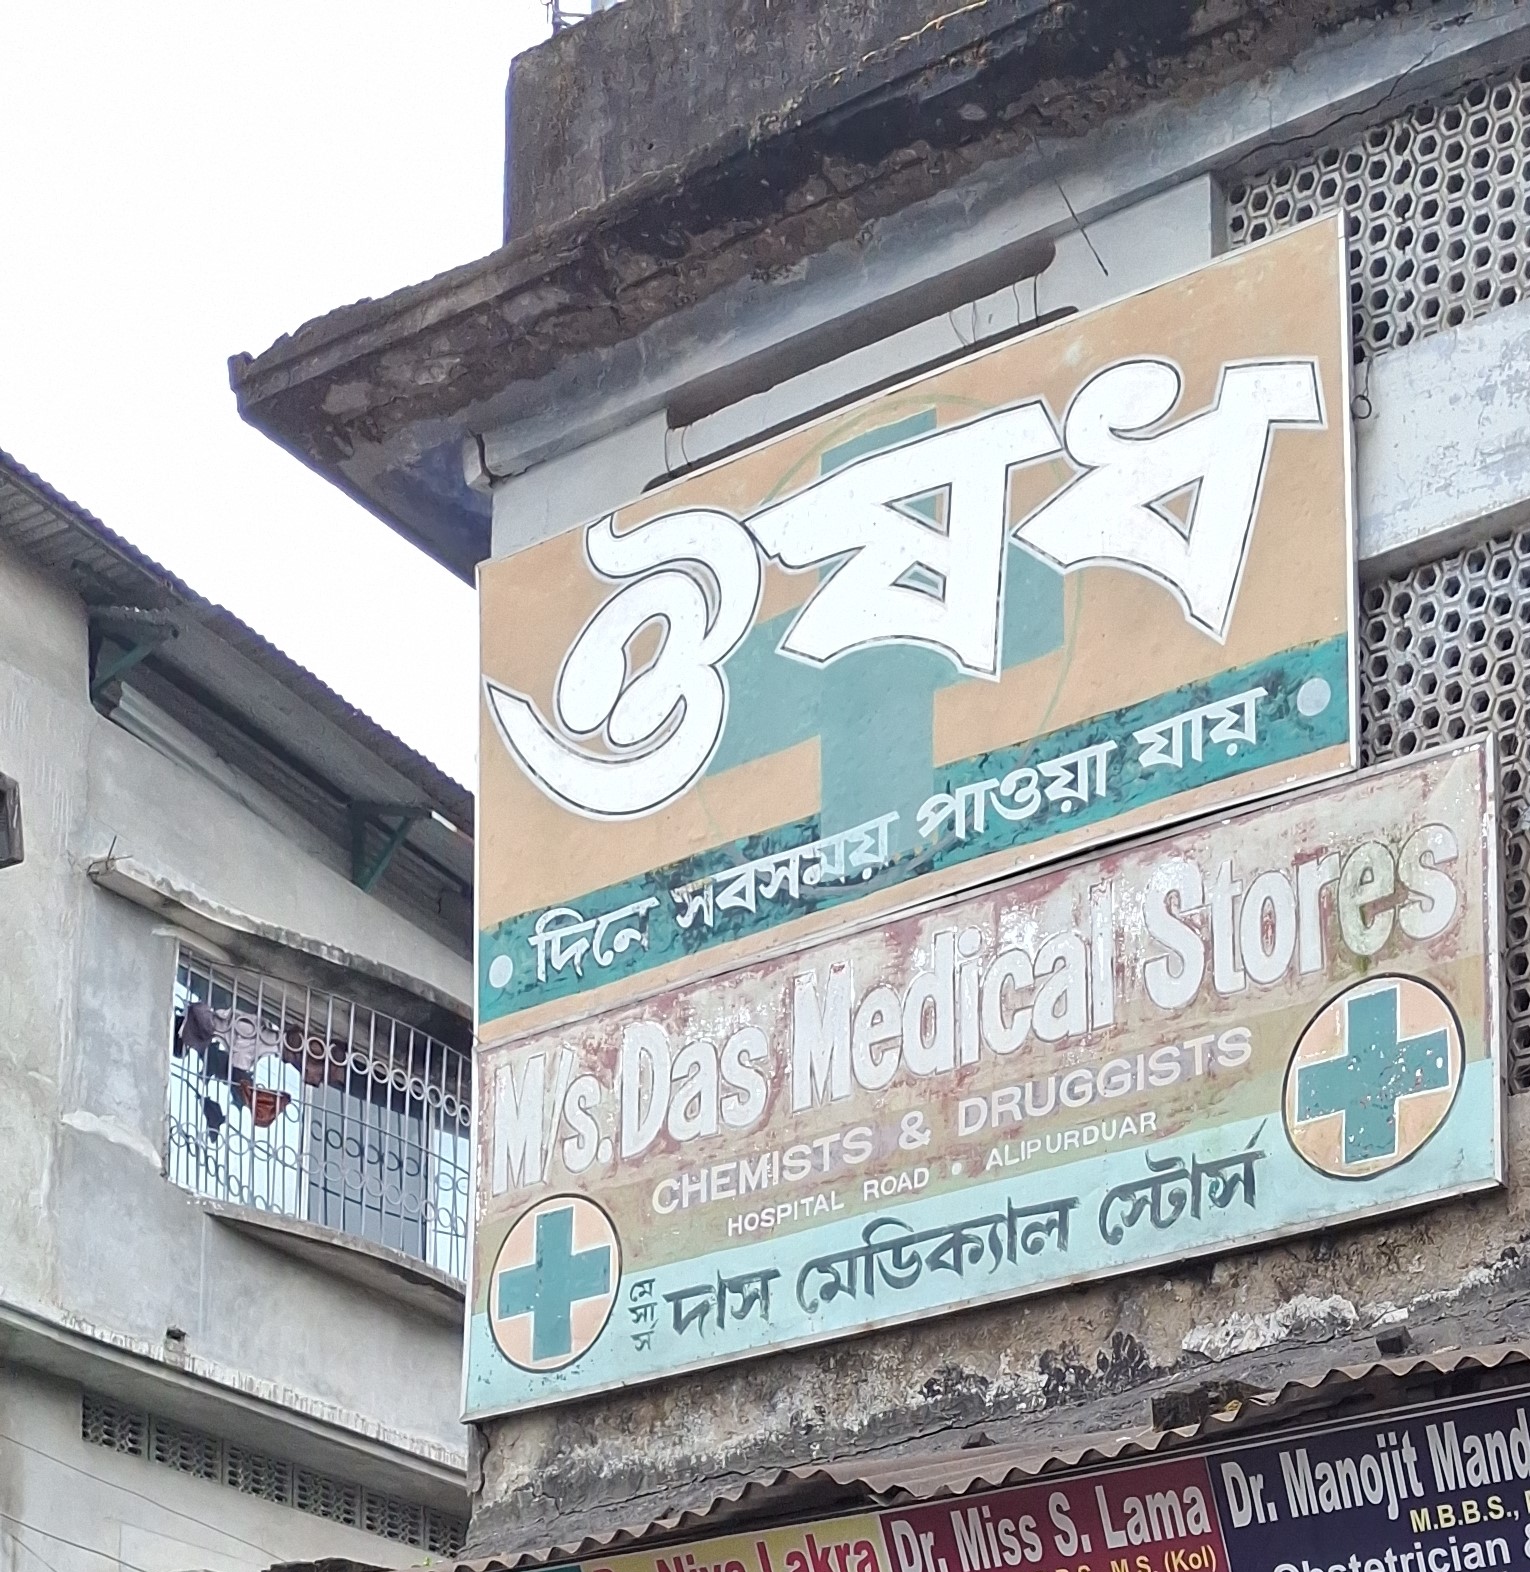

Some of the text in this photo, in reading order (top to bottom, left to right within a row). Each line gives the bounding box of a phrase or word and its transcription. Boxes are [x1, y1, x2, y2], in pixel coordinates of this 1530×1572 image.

[528, 687, 1268, 982] দিনে সবসময় পাওয়া যায়
[793, 879, 1117, 1114] Medical
[1142, 823, 1459, 1010] Stores
[652, 1026, 1253, 1215] CHEMISTS & DRUGGISTS
[728, 1112, 1158, 1237] HOSPITAL ROAD ALIPURDUAR
[662, 1268, 781, 1339] দাস
[796, 1196, 1082, 1313] মেডিক্যাল
[1099, 1119, 1271, 1245] স্টোর্স
[949, 1507, 1044, 1572] Miss
[1048, 1491, 1092, 1557] S.
[1095, 1484, 1211, 1549] Lama
[1221, 1461, 1278, 1529] Dr.
[1278, 1431, 1424, 1521] Manojit
